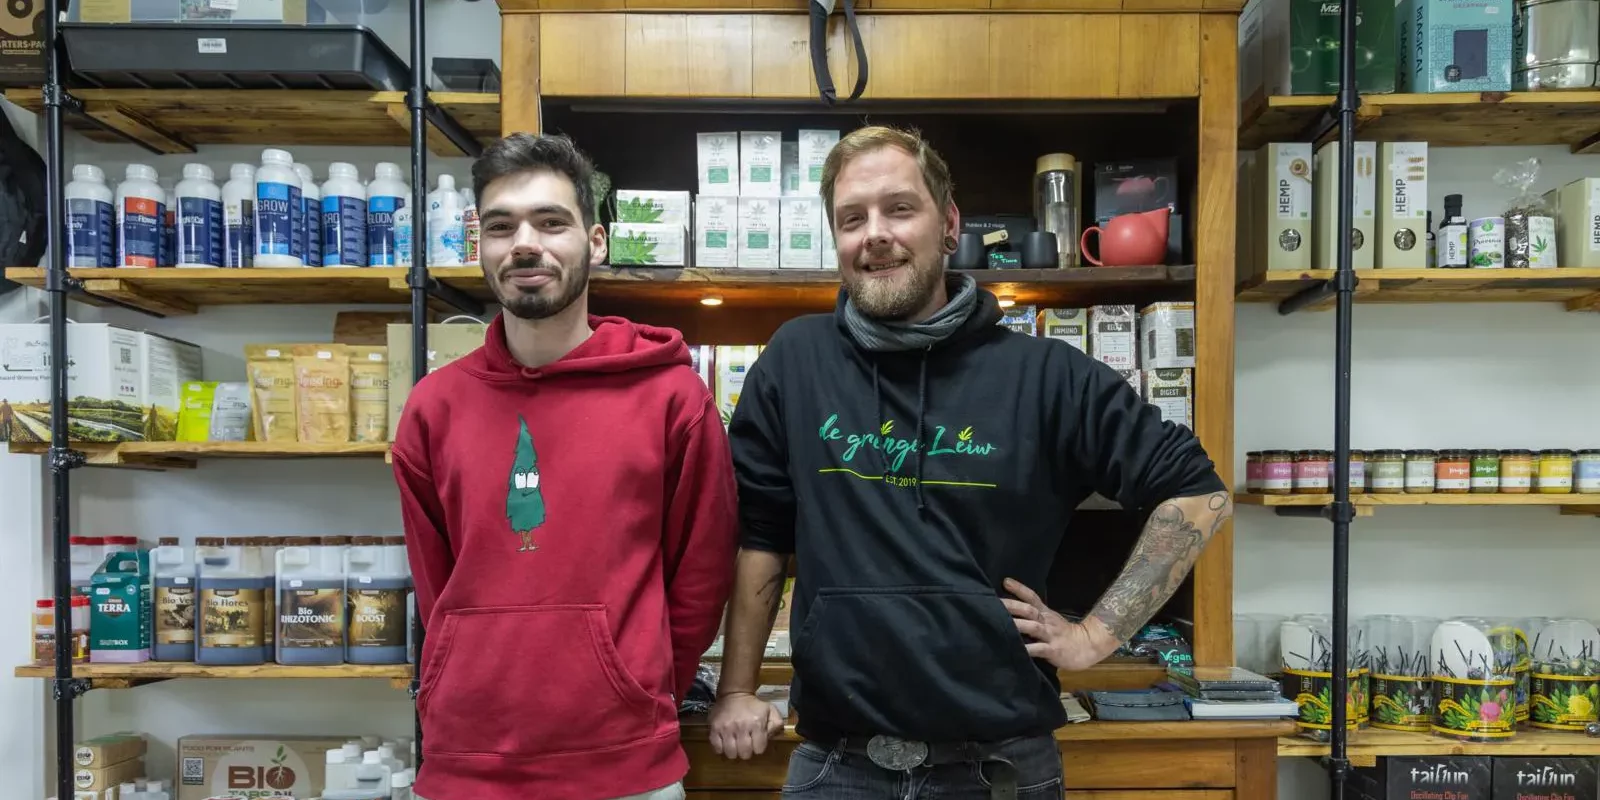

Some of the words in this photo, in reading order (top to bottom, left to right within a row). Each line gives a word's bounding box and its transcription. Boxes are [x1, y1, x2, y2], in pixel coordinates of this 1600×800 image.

[1279, 179, 1291, 214] HEMP
[1395, 178, 1406, 213] HEMP
[258, 199, 289, 212] GROW
[1448, 241, 1456, 260] HEMP
[1159, 388, 1179, 396] DIGEST
[819, 413, 844, 441] de
[162, 597, 176, 605] Bio
[221, 599, 249, 607] Flores
[97, 603, 132, 613] TERRA
[298, 606, 313, 615] Bio
[280, 614, 336, 624] RHIZOTONIC
[356, 614, 386, 623] BOOST
[1160, 649, 1192, 664] Vegan
[228, 765, 296, 790] BIO
